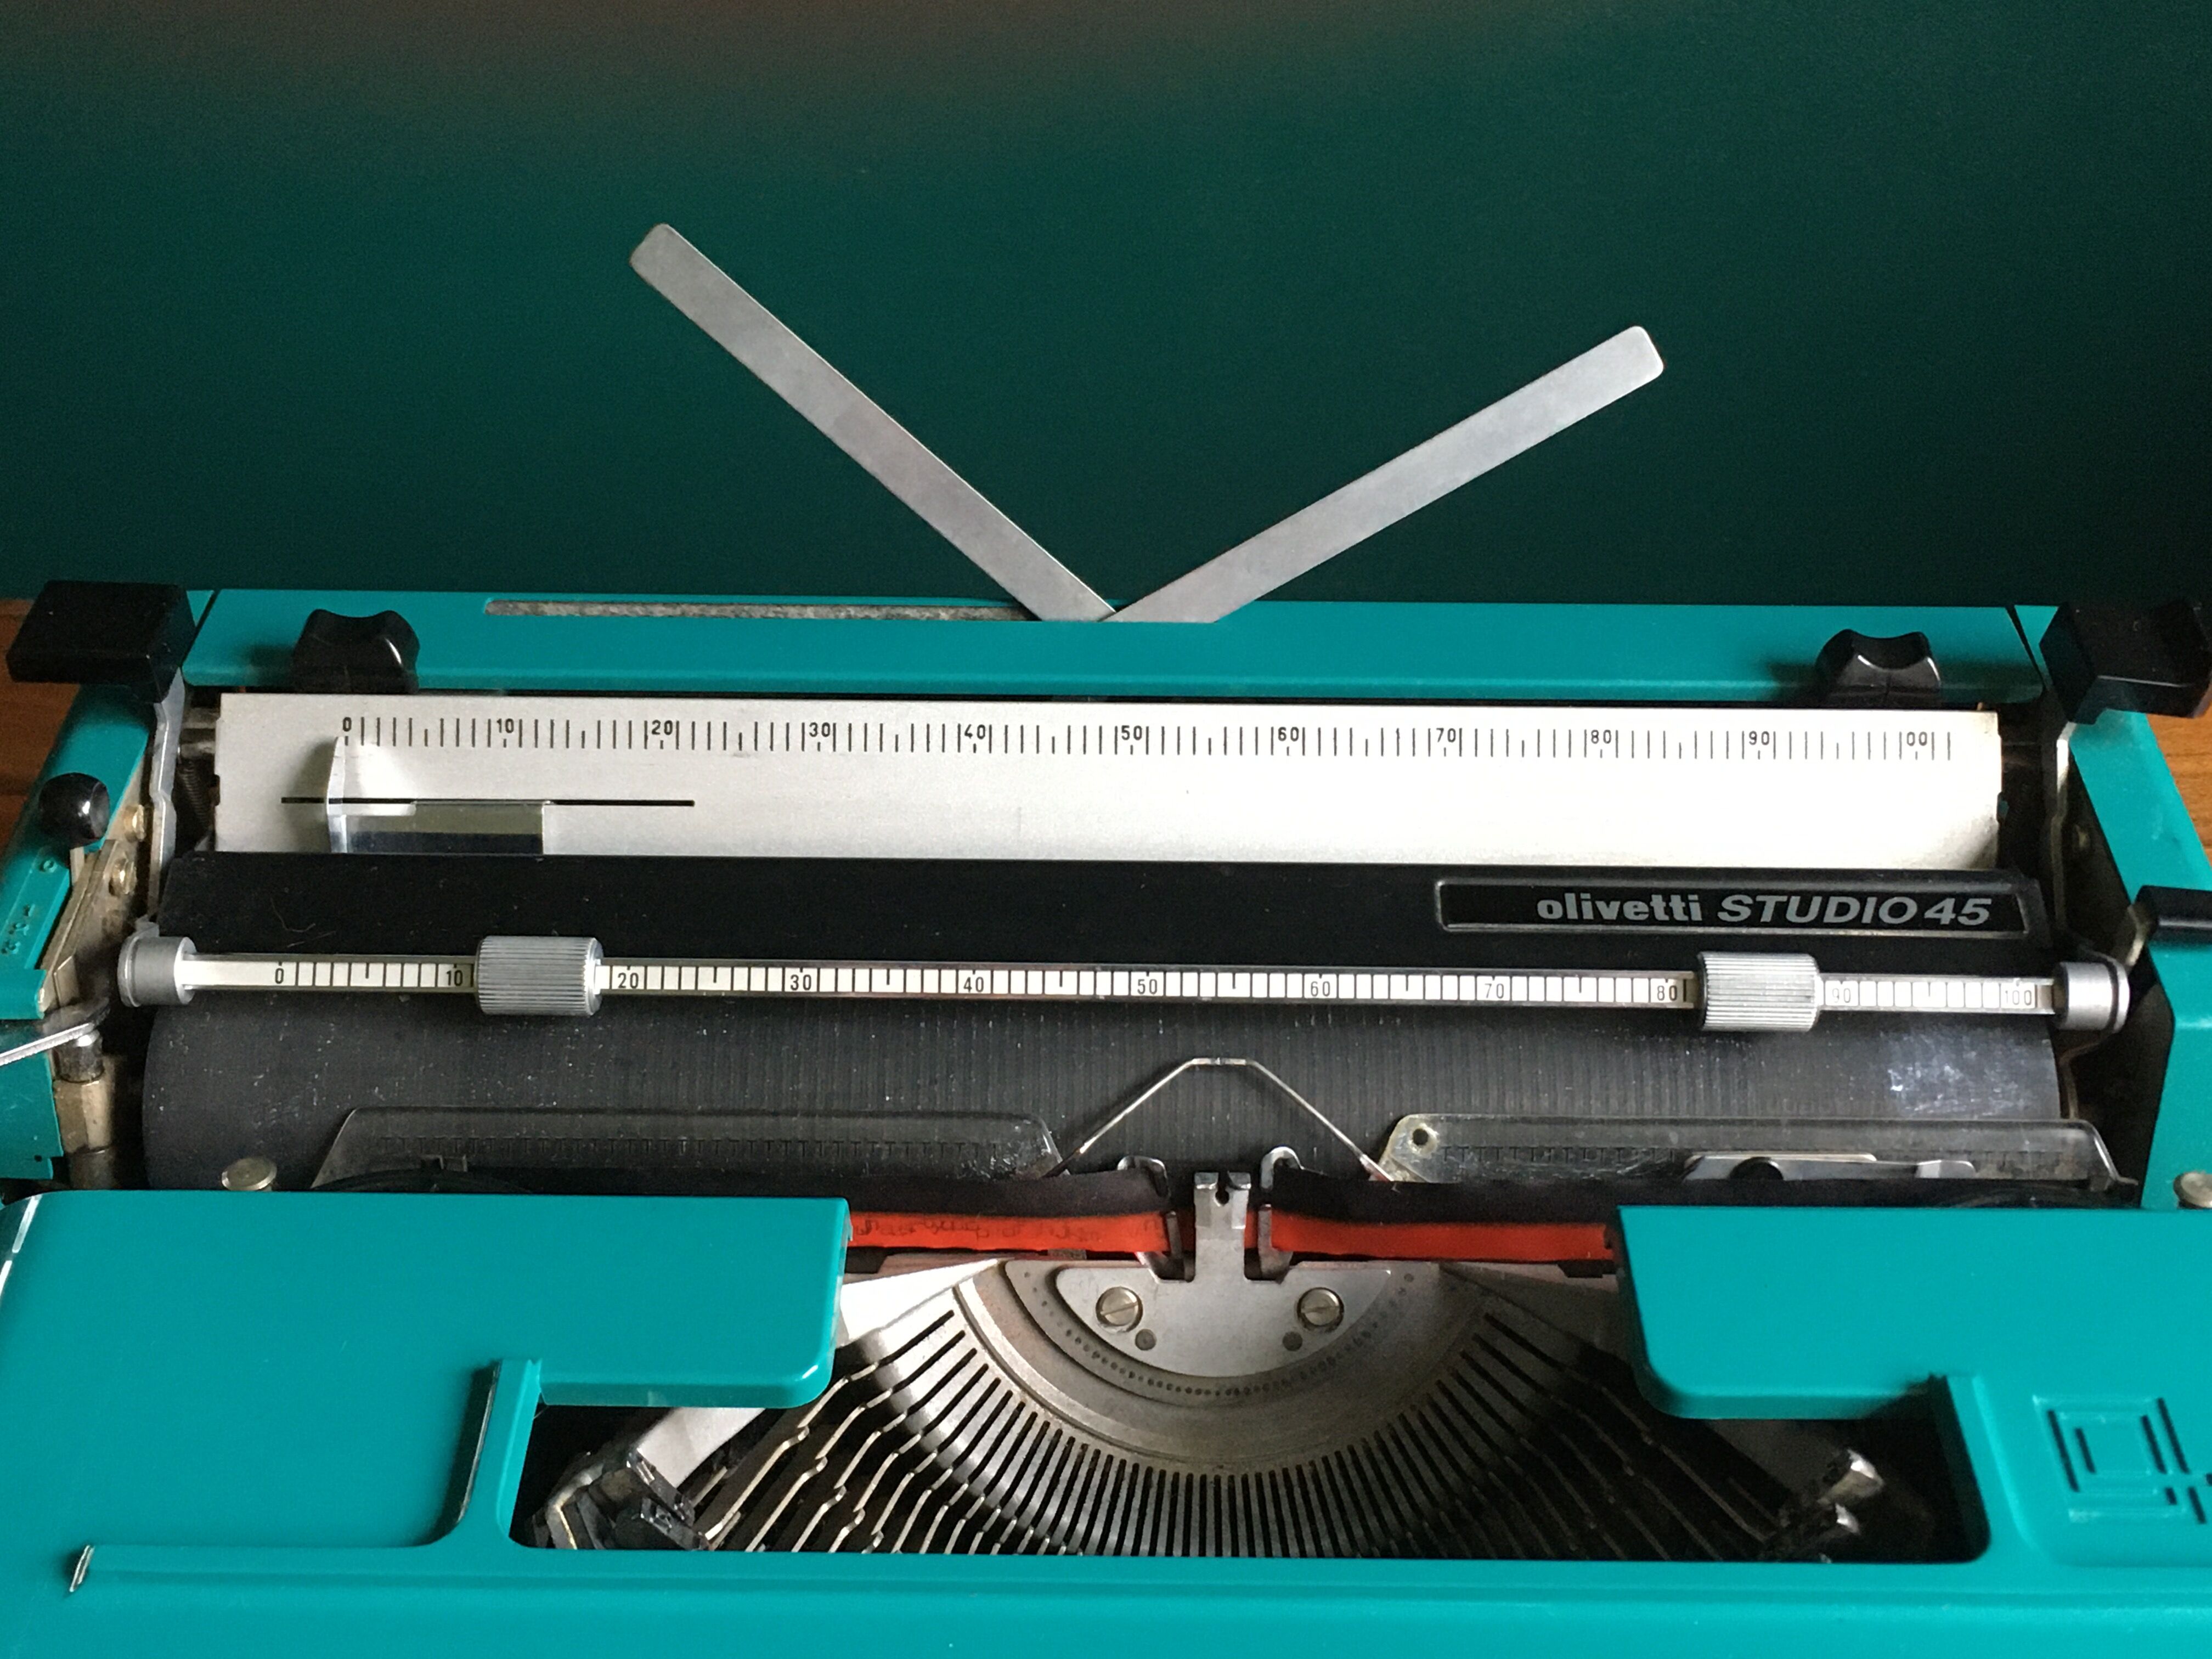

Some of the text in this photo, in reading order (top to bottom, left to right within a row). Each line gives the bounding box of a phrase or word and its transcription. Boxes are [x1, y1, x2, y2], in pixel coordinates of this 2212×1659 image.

[342, 716, 352, 732] 0
[496, 718, 514, 733] 10
[651, 720, 673, 736] 20
[809, 722, 831, 737] 30
[964, 724, 986, 740] 40
[1121, 725, 1143, 741] 50
[1278, 726, 1299, 742] 60
[1436, 727, 1456, 743] 70
[1590, 729, 1612, 744] 80
[1748, 731, 1770, 746] 90
[1537, 893, 1992, 926] olivetti STUDIO 45
[275, 968, 2032, 1006] 0 10 20 30 40 50 60 70 80 90 100
